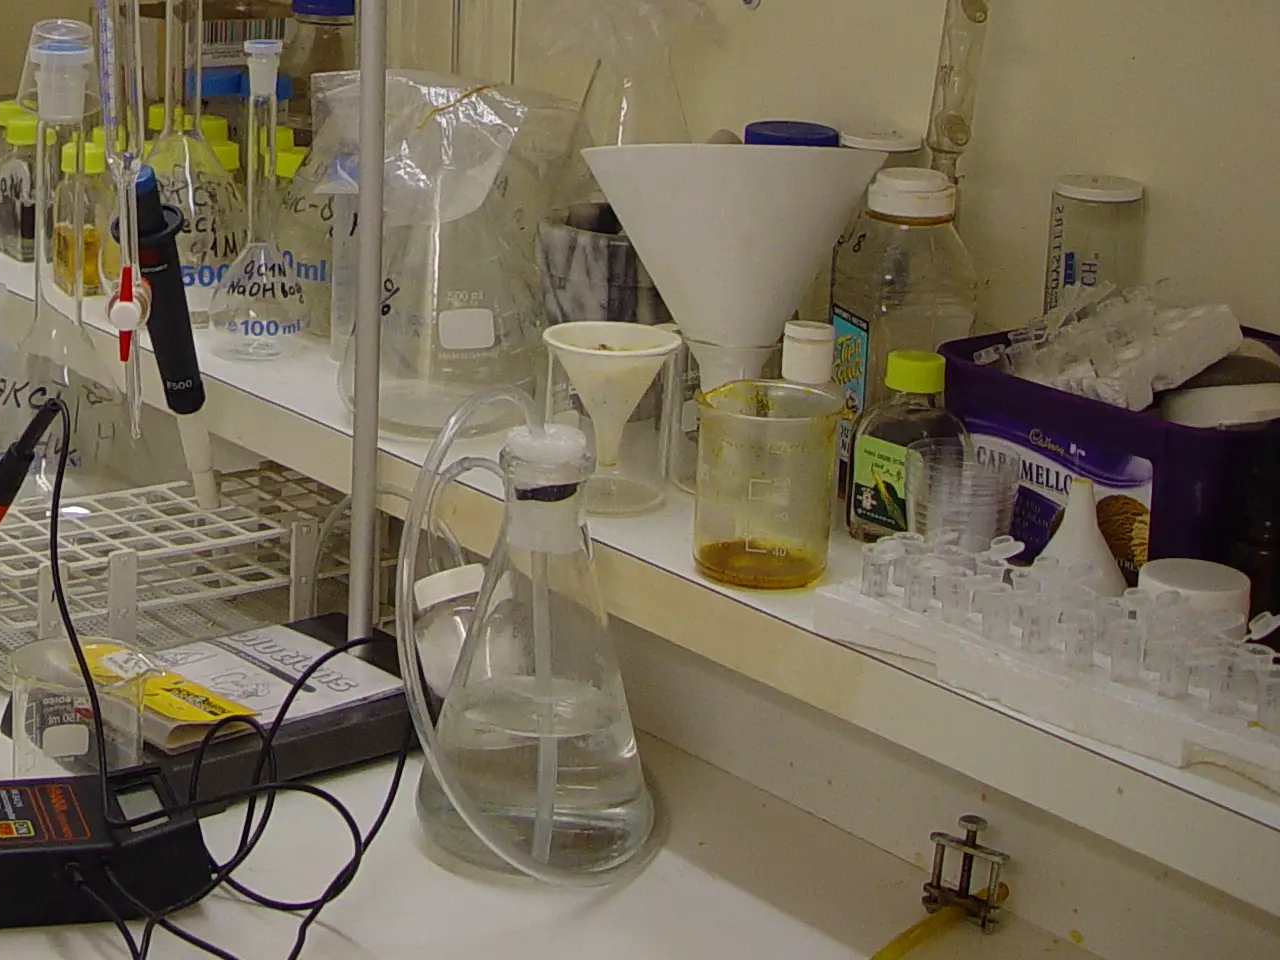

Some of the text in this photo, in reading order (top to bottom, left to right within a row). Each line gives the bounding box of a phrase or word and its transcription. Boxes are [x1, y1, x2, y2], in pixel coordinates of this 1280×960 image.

[226, 279, 276, 299] NaOH
[240, 318, 301, 337] 100 ml
